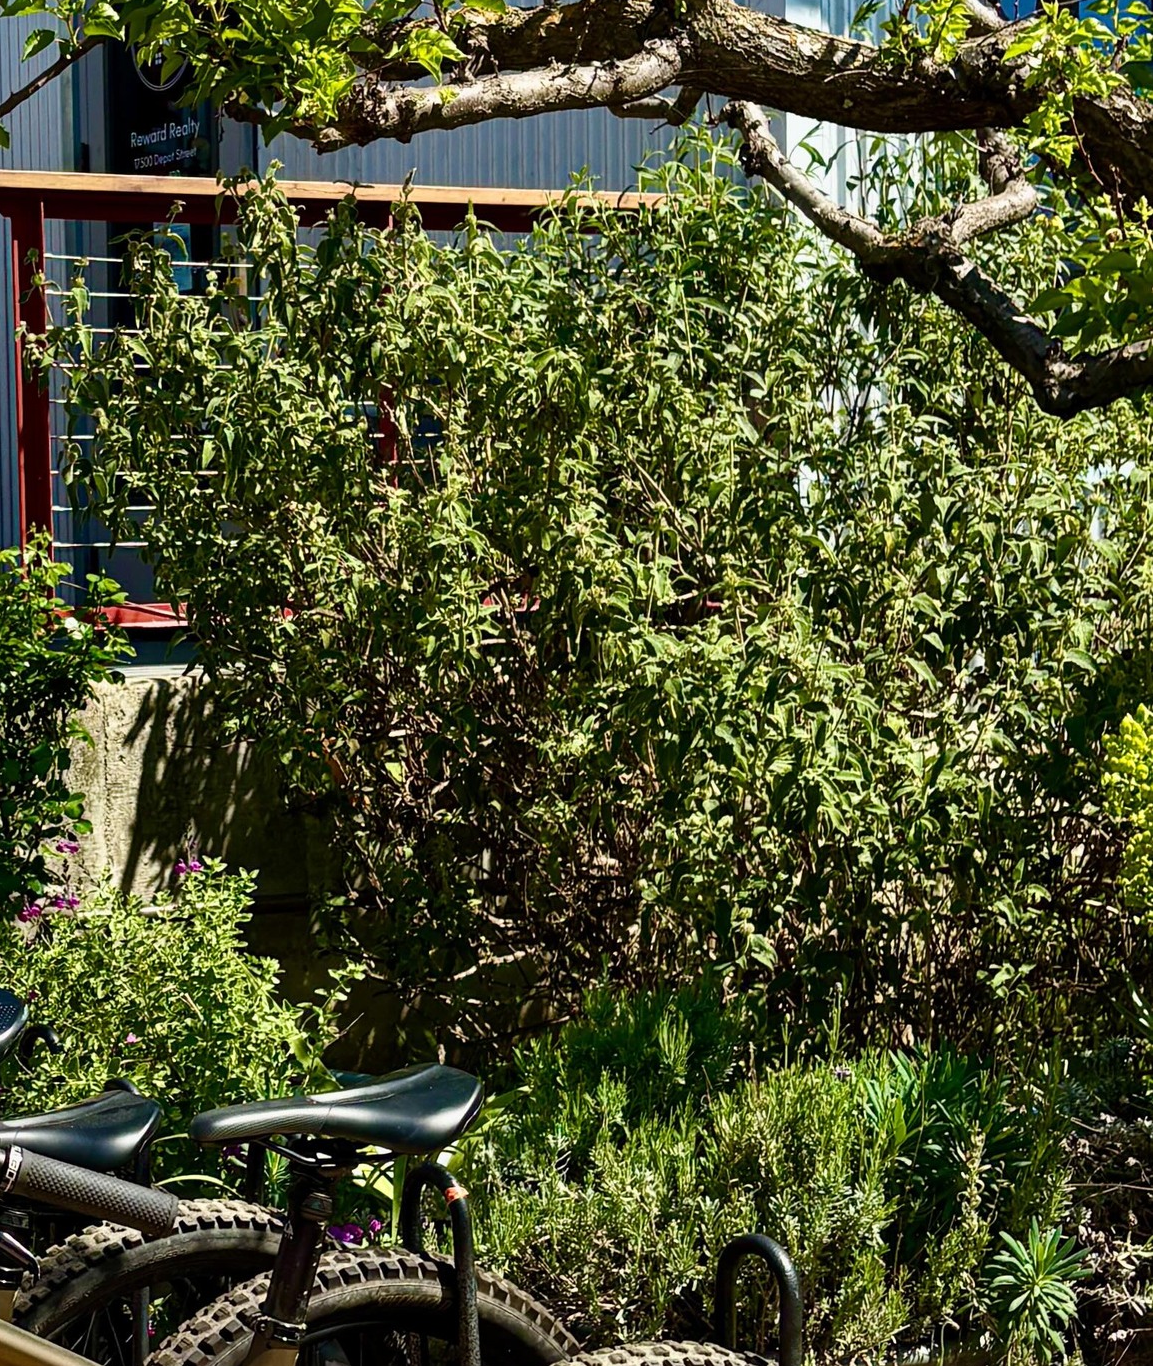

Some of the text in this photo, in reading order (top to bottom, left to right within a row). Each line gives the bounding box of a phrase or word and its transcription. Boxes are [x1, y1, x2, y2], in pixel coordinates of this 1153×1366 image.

[130, 116, 200, 148] Reward Realty
[154, 152, 175, 166] Depot
